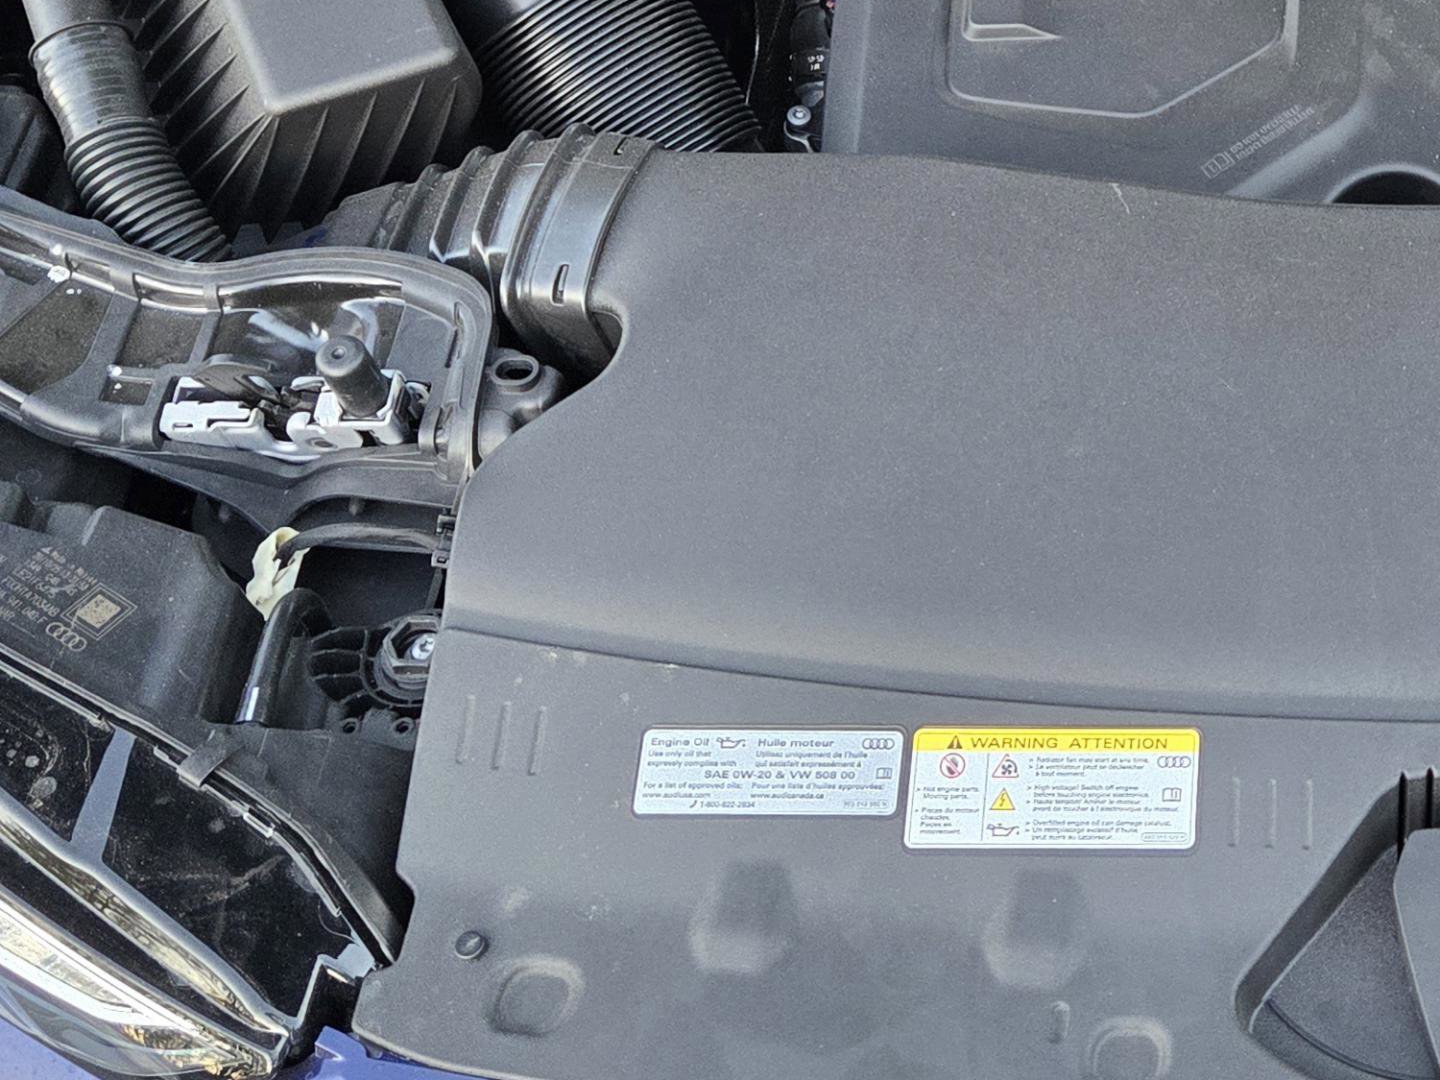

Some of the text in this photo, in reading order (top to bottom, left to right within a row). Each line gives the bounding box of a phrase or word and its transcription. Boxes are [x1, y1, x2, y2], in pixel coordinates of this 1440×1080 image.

[651, 737, 710, 748] Engine Oil
[758, 738, 834, 748] Huile moteur
[970, 737, 1168, 750] WARNING ATTENTION
[704, 770, 856, 780] SAE 0W-20 & VW 508 00
